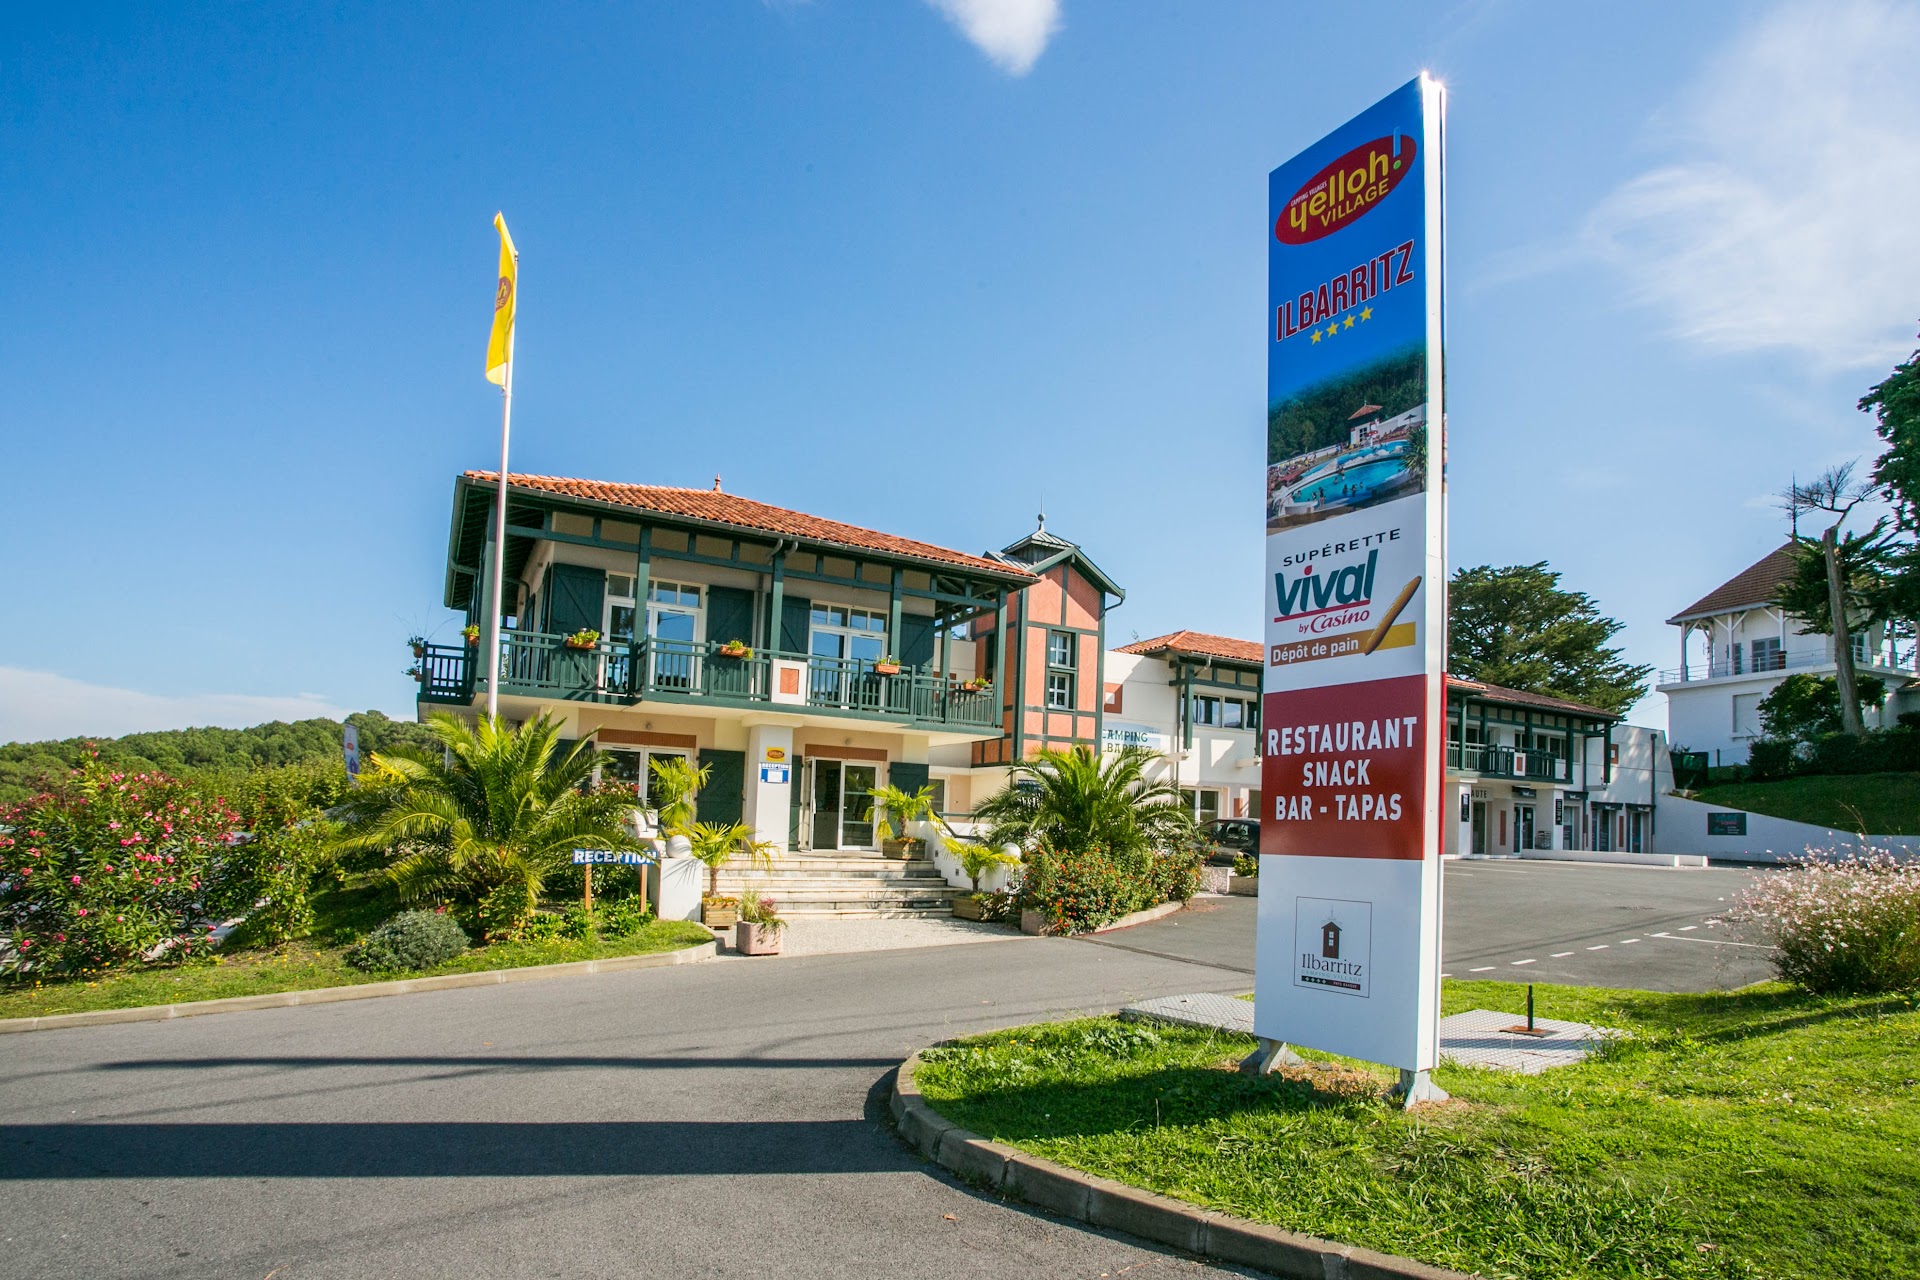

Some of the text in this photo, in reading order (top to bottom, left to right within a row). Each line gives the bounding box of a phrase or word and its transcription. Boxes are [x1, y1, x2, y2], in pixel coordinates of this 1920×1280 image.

[1290, 126, 1402, 233] yelloh!
[1320, 177, 1389, 227] VILLAGE
[1276, 239, 1415, 342] ILBARRITZ
[1283, 528, 1401, 567] SUPÉRETTE
[1298, 609, 1370, 634] by Casino
[1272, 638, 1359, 663] Dépôt de pain
[1267, 716, 1418, 757] RESTAURANT
[1302, 759, 1371, 787] SNACK
[1275, 795, 1312, 821] BAR
[1335, 793, 1402, 821] TAPAS
[1301, 953, 1362, 977] Ilbarritz
